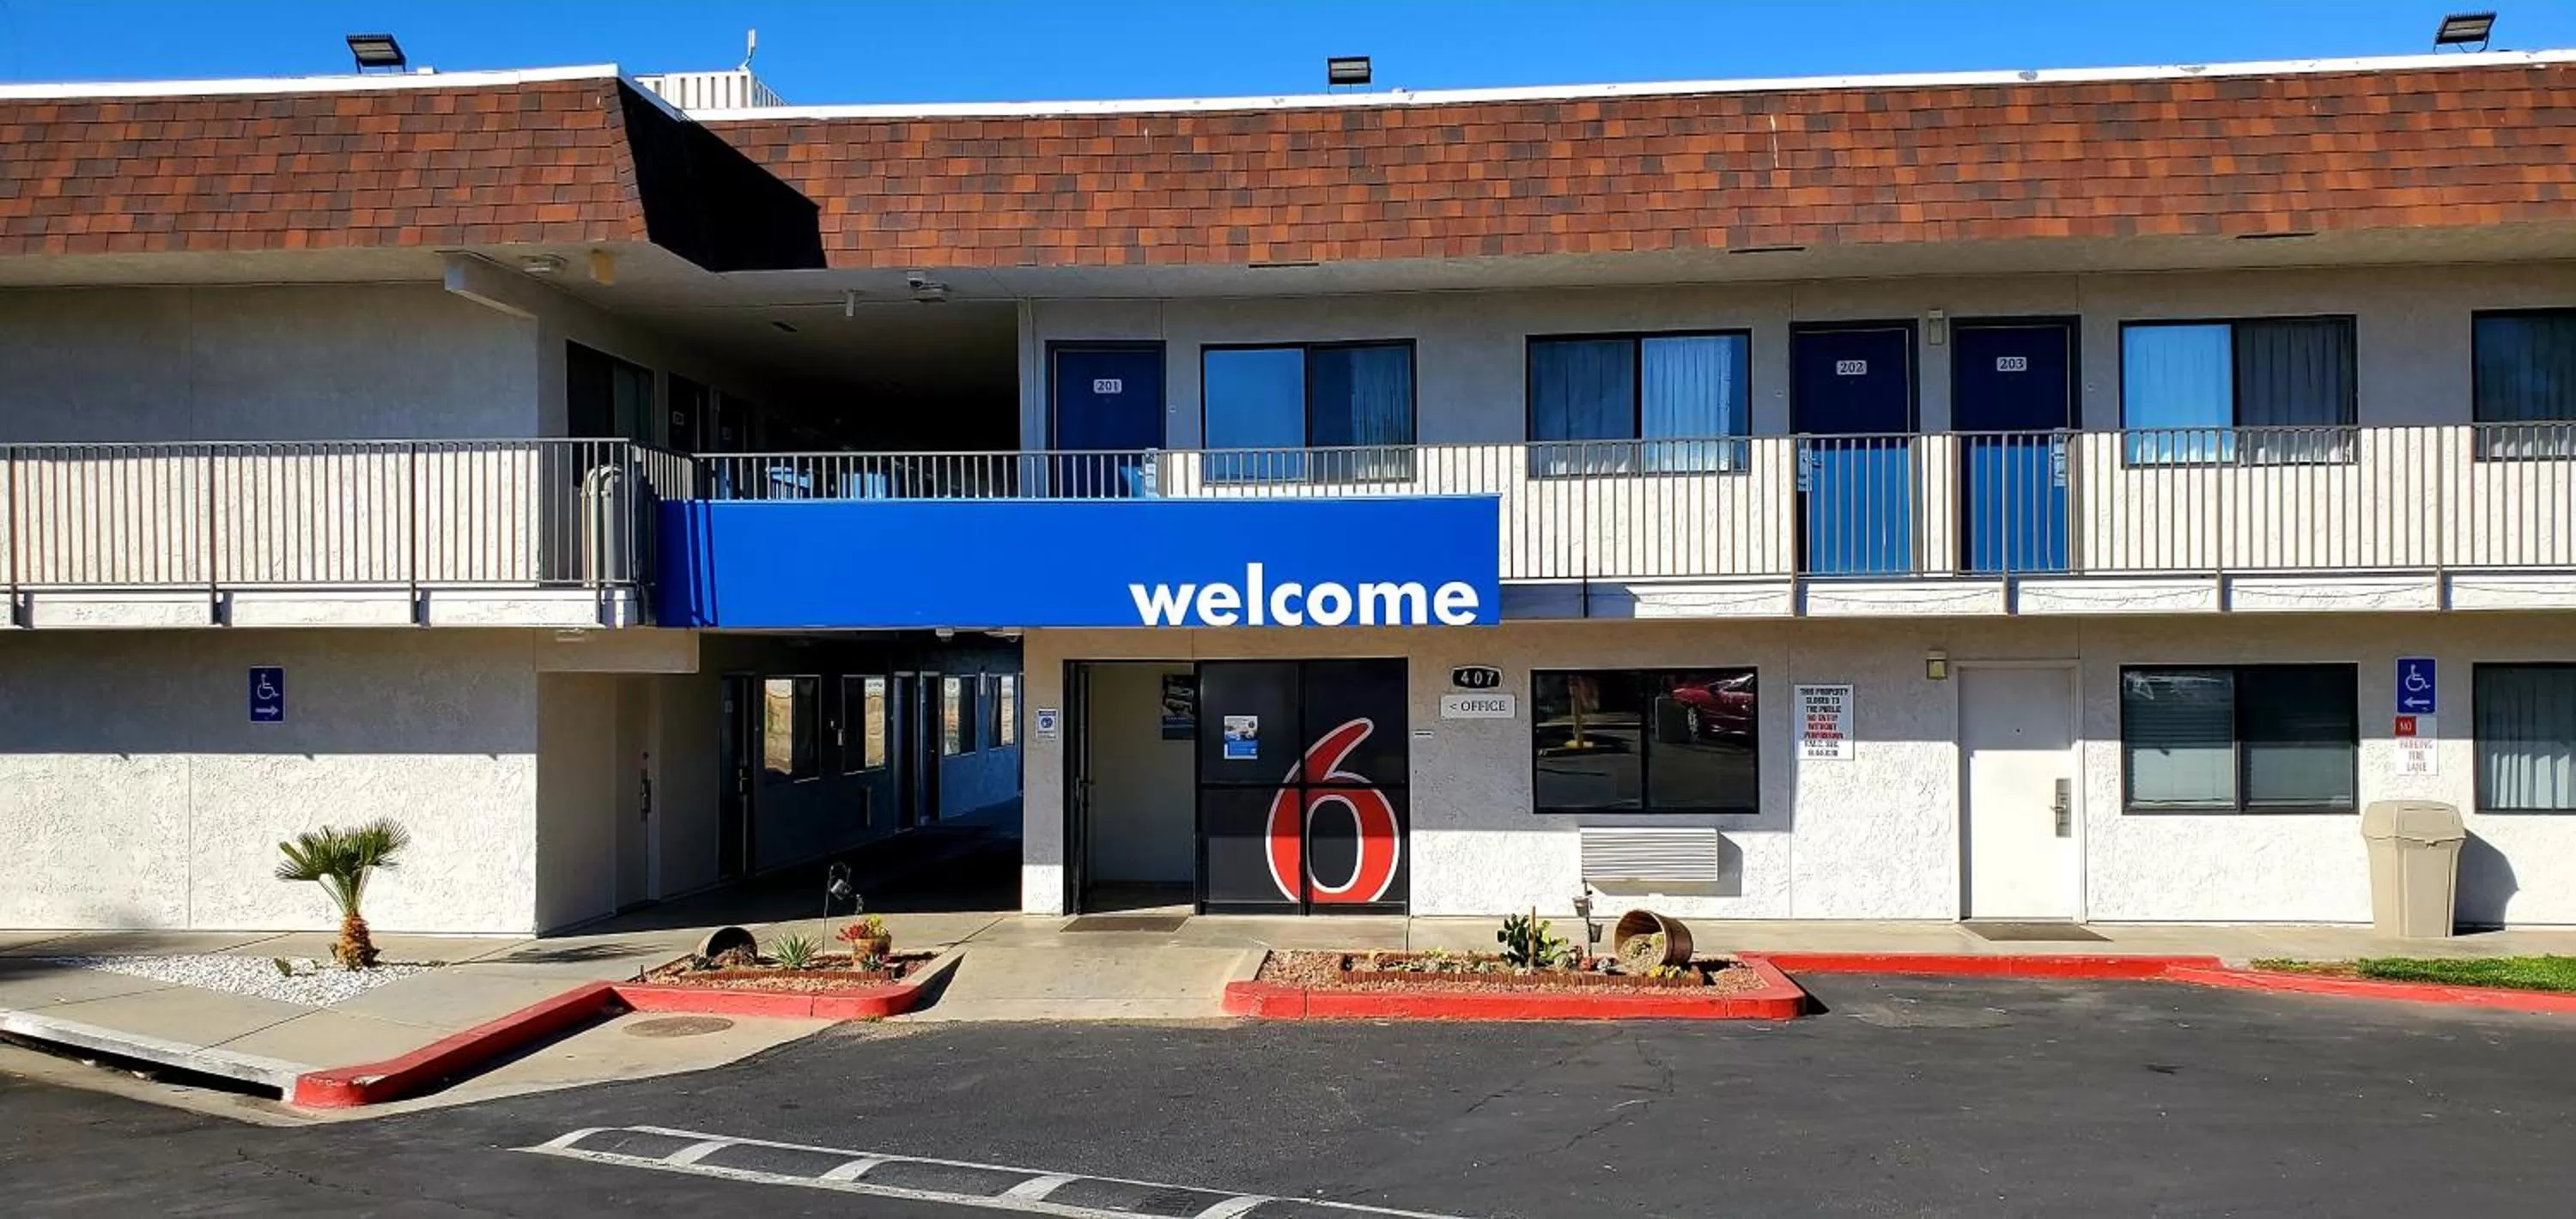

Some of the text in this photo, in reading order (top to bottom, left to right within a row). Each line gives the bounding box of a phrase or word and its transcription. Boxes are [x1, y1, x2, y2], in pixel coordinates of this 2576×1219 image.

[1840, 361, 1864, 373] 202
[2000, 358, 2024, 369] 203
[1097, 380, 1117, 391] 201
[1128, 563, 1479, 626] welcome
[1461, 670, 1494, 686] 407
[1461, 700, 1505, 712] OFFICE
[1266, 718, 1400, 904] 6
